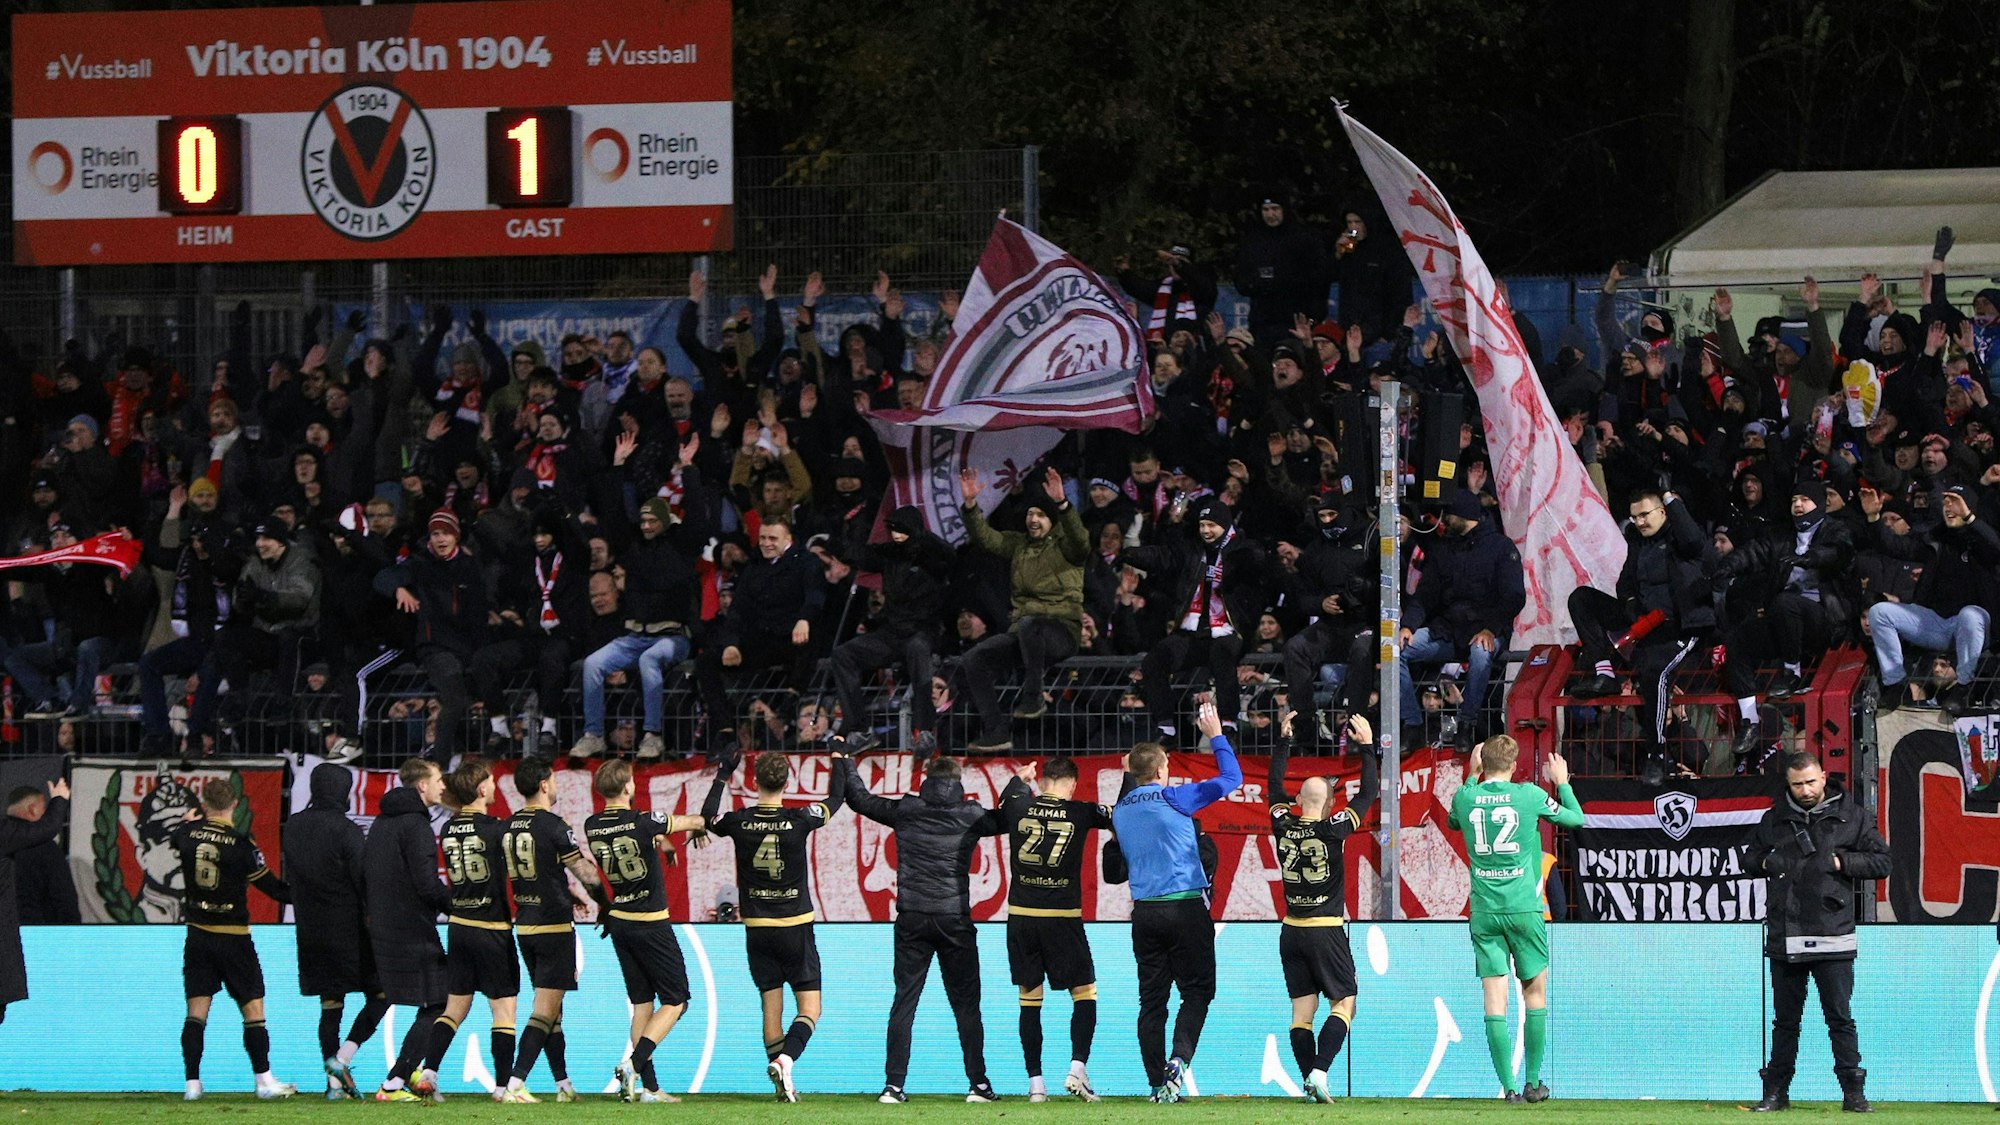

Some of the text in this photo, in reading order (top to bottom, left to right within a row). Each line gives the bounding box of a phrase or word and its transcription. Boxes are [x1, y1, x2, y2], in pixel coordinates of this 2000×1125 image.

[186, 36, 552, 77] Viktoria Köln 1904
[587, 39, 697, 66] #Vussball
[45, 53, 152, 80] #Vussball
[348, 93, 388, 111] 1904
[638, 131, 697, 154] Rhein
[81, 147, 138, 166] Rhein
[178, 126, 217, 203] 0
[507, 117, 538, 196] 1
[638, 155, 719, 180] Energie
[81, 170, 160, 193] Energie
[309, 146, 428, 233] VIKTORIA KÖLN
[177, 226, 233, 246] HEIM
[505, 217, 564, 238] GAST
[1475, 793, 1511, 804] BETHKE
[741, 821, 793, 831] CAMPULKA
[1027, 807, 1067, 819] SLAMAR
[190, 830, 236, 846] HOFMANN
[1018, 818, 1075, 867] 27
[1468, 806, 1520, 856] 12
[195, 842, 221, 891] 6
[442, 835, 491, 886] 36
[502, 832, 537, 881] 19
[590, 835, 648, 884] 28
[753, 834, 785, 880] 4
[1279, 838, 1331, 884] 23
[1578, 844, 1752, 879] PSEUDOFA
[1019, 874, 1070, 888] Koalick.de
[1475, 867, 1524, 877] Koalick.de
[749, 887, 799, 898] Koalick.de
